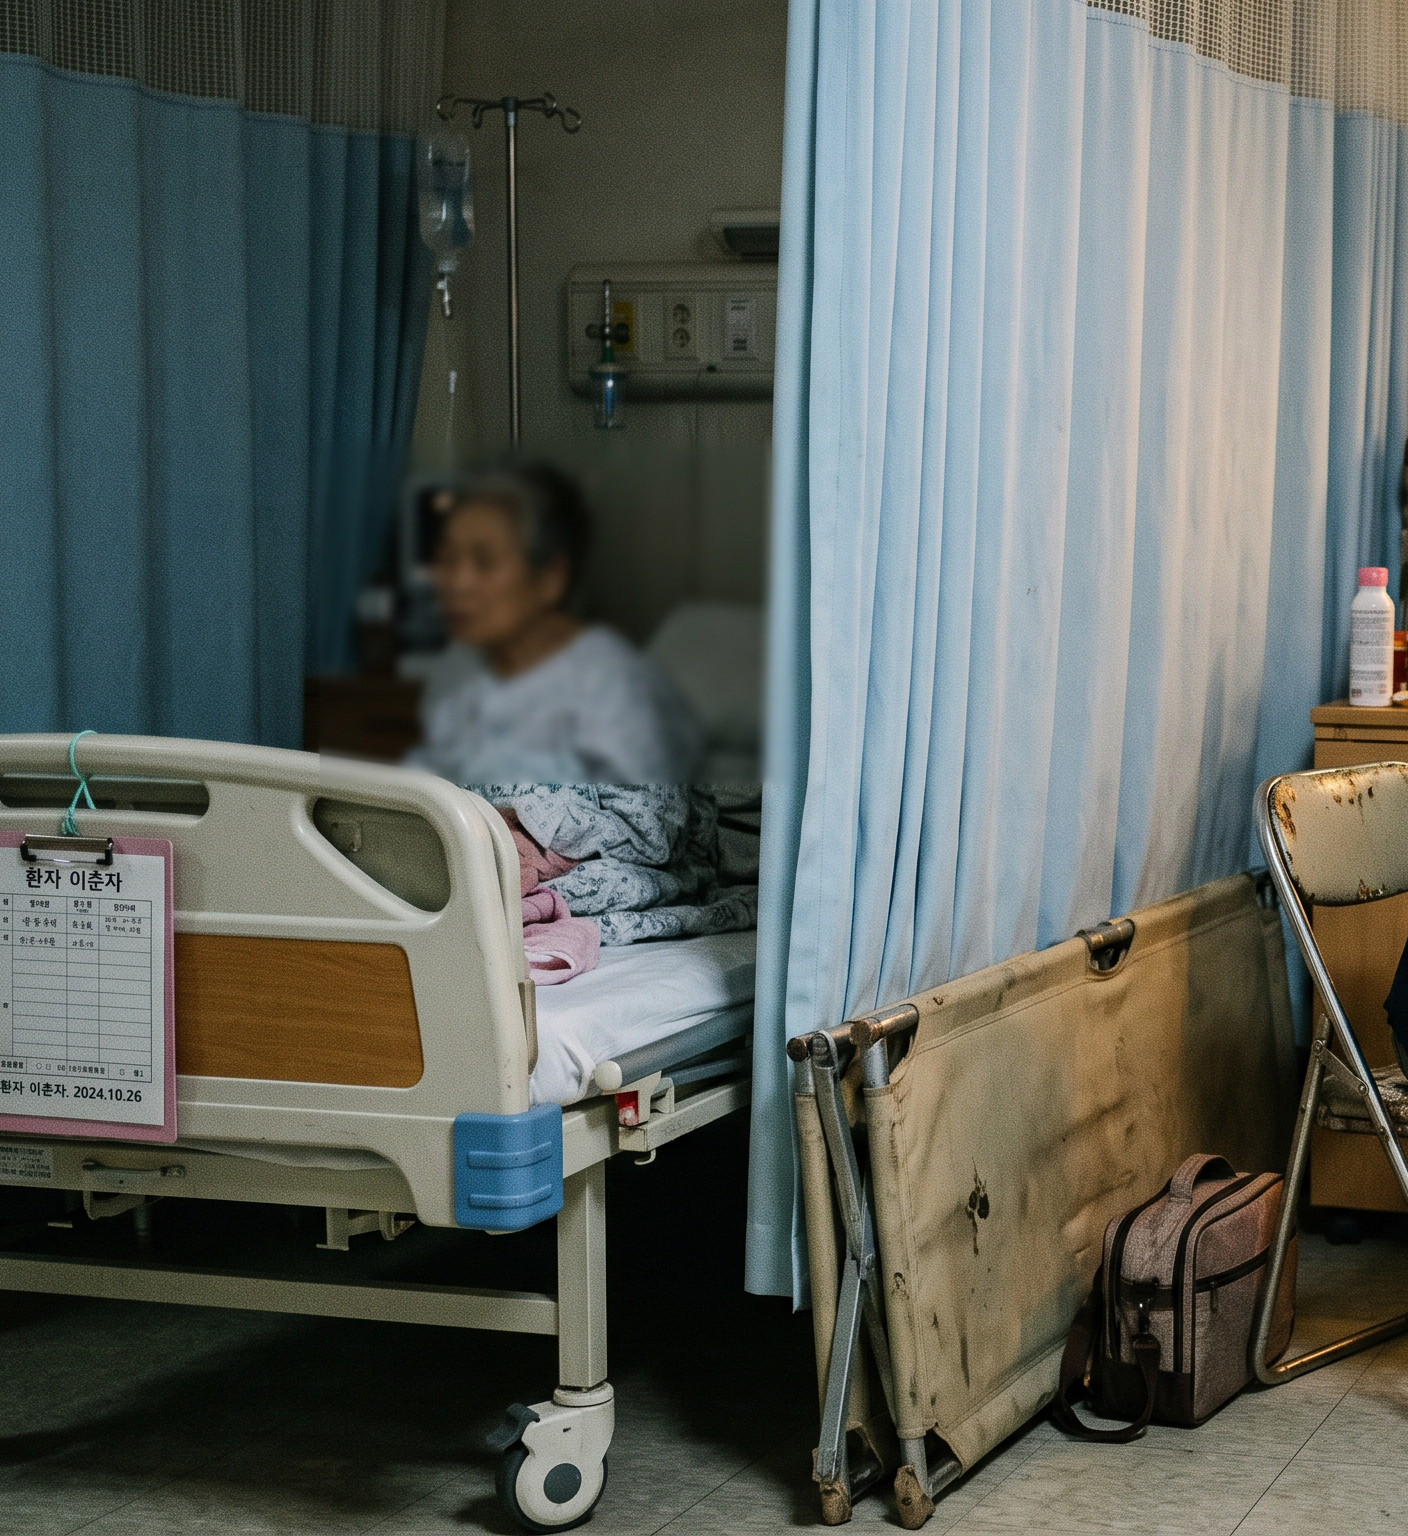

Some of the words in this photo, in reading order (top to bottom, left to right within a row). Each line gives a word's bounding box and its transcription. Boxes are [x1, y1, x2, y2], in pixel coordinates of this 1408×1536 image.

[26, 867, 61, 889] 환자
[70, 870, 122, 893] 이춘자
[73, 1086, 142, 1103] 2024.10.26
